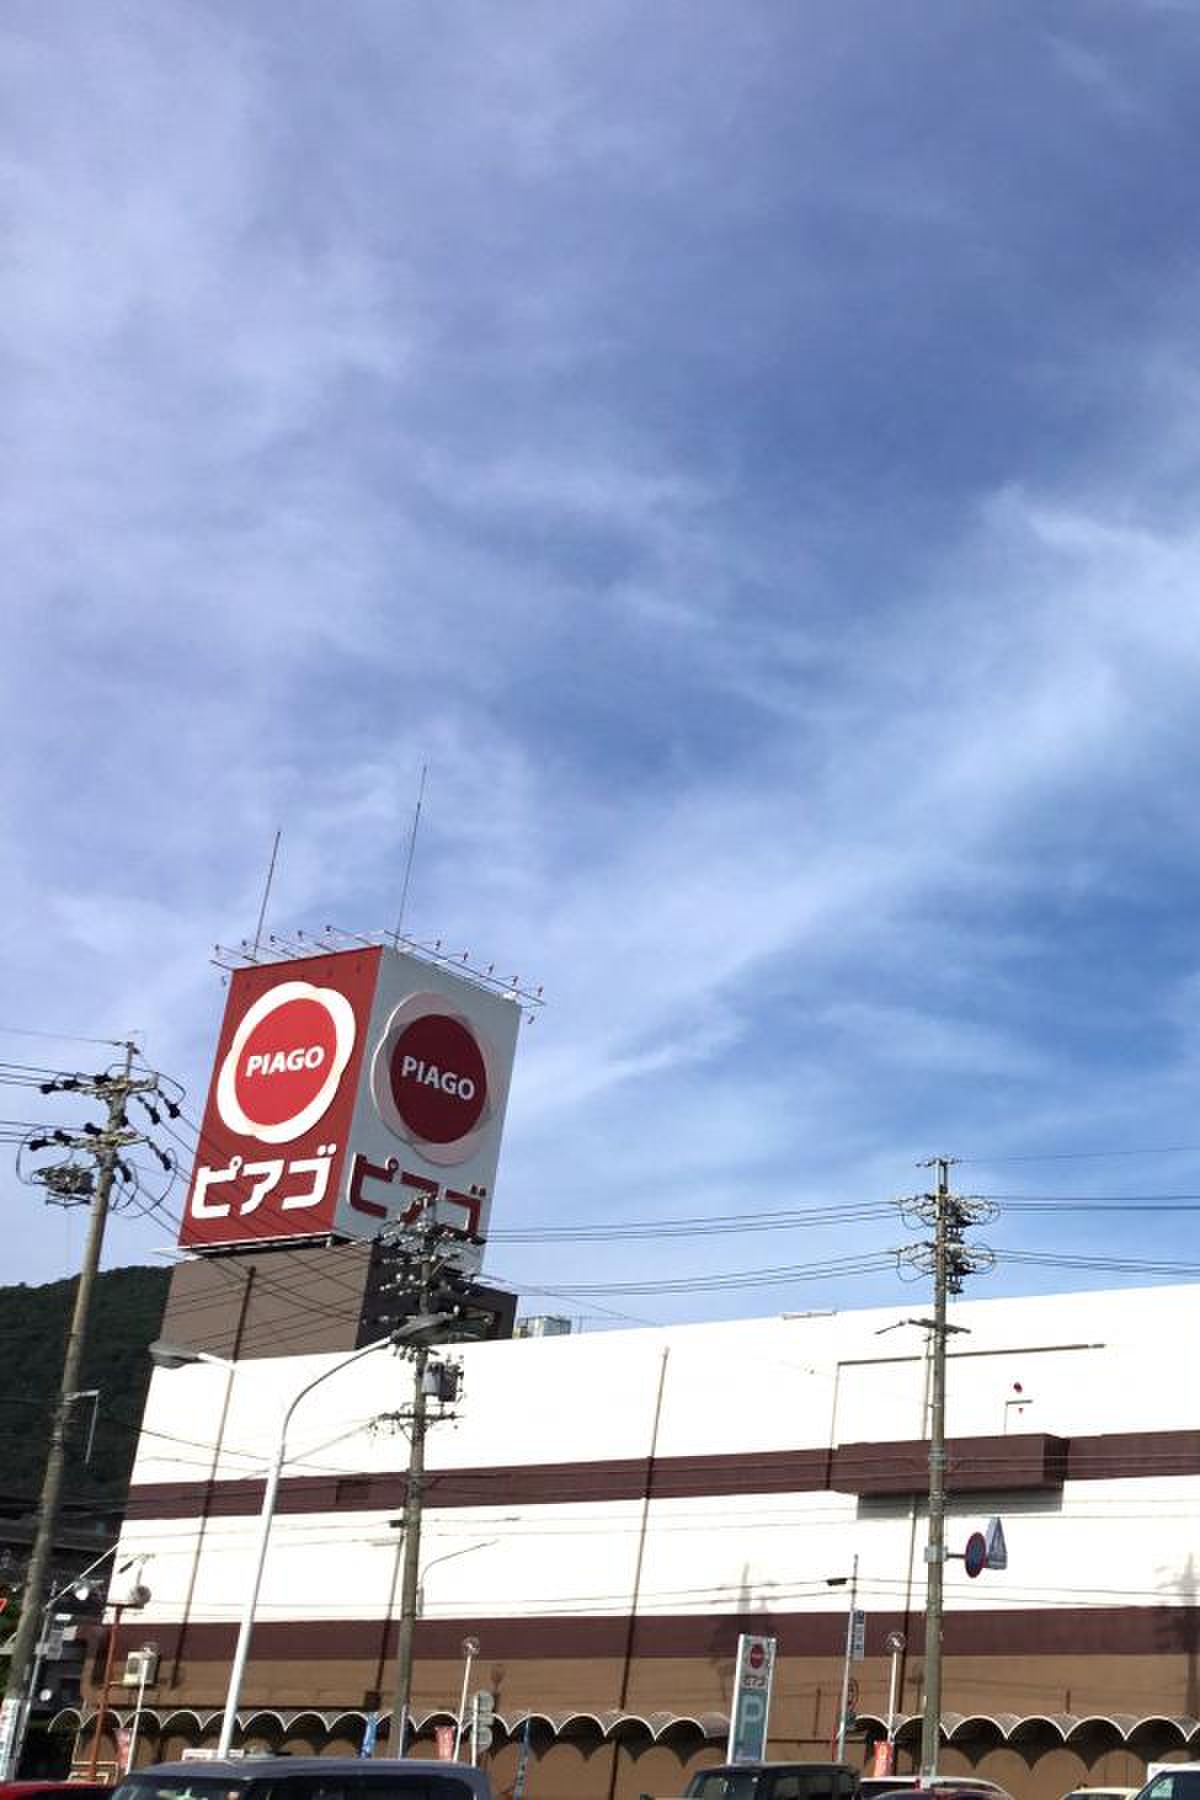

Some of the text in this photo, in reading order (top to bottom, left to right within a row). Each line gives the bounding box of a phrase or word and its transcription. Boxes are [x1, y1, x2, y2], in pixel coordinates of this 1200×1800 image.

[245, 1046, 325, 1077] PIAGO
[401, 1055, 476, 1101] PIAGO
[191, 1144, 337, 1219] ピアゴ
[740, 1695, 763, 1741] P
